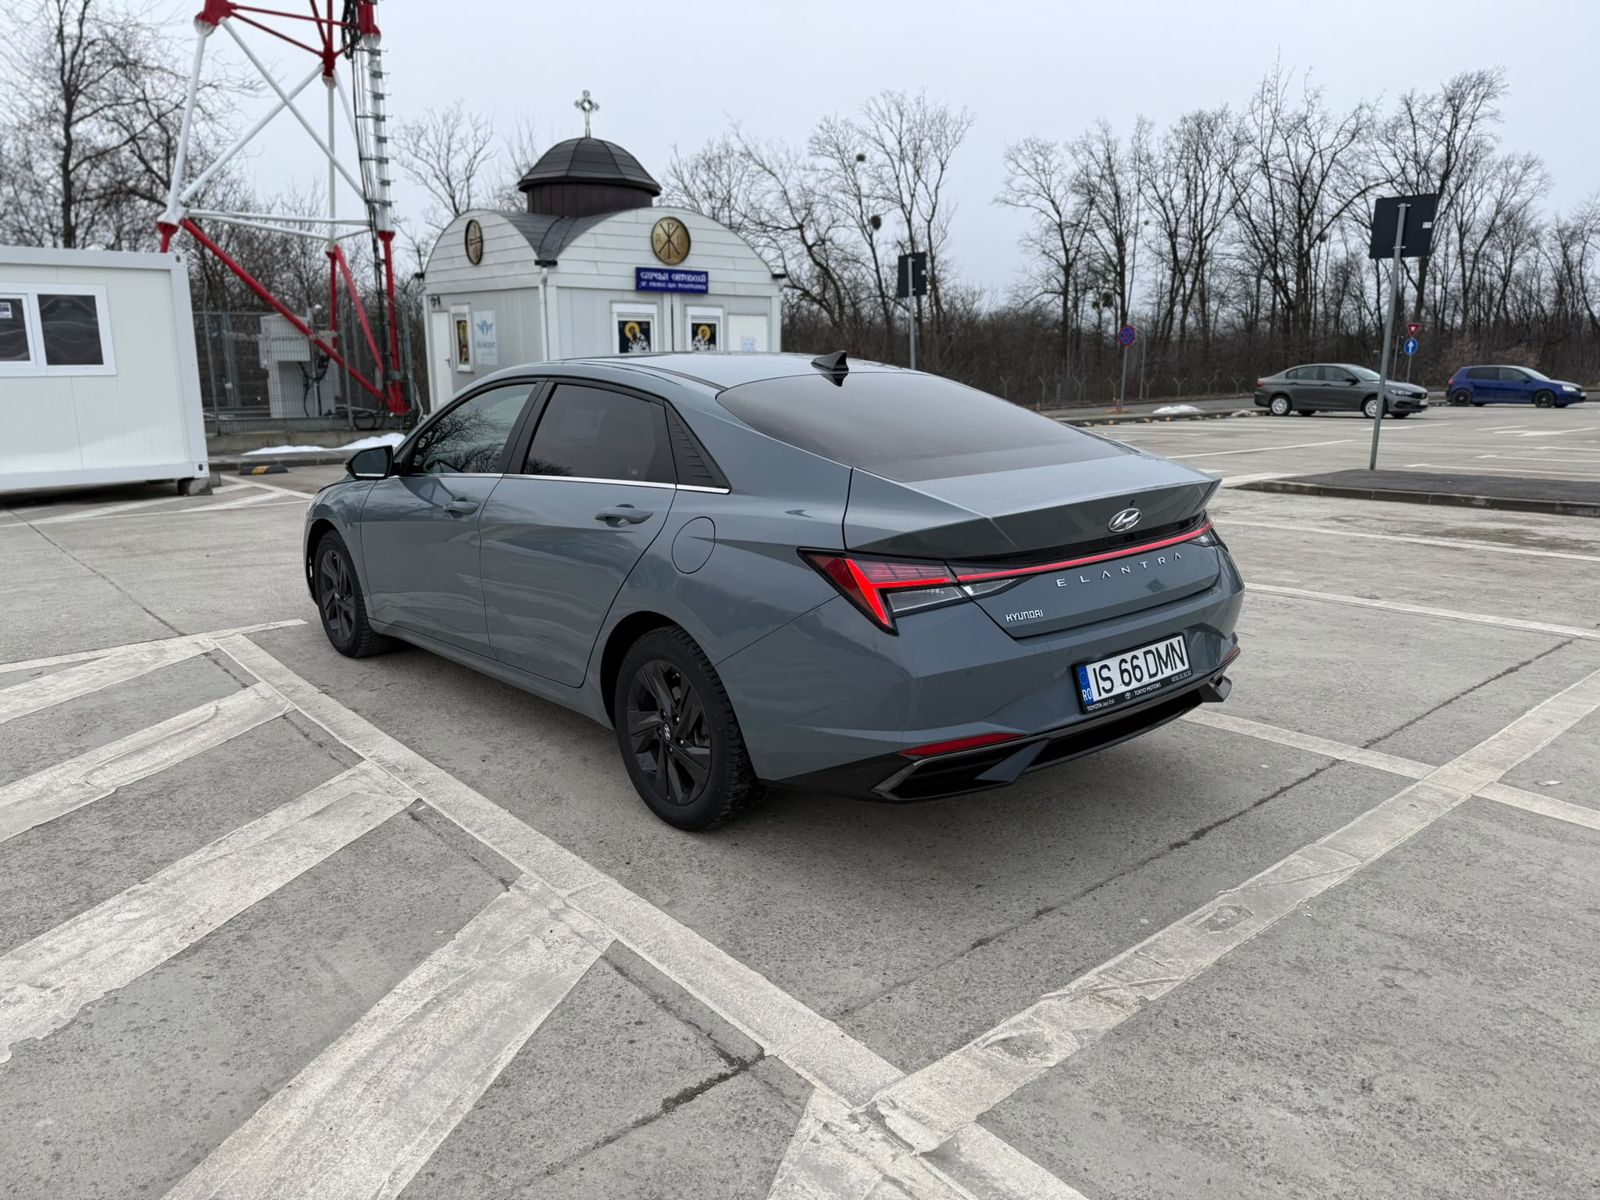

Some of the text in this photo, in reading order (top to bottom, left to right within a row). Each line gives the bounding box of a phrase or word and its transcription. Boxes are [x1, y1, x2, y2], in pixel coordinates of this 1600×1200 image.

[1056, 553, 1182, 587] ELANTRA
[1005, 609, 1044, 622] HYUNDAI
[1092, 663, 1115, 697] IS
[1118, 654, 1144, 687] 66
[1143, 639, 1186, 680] DMN
[1081, 688, 1093, 702] RO
